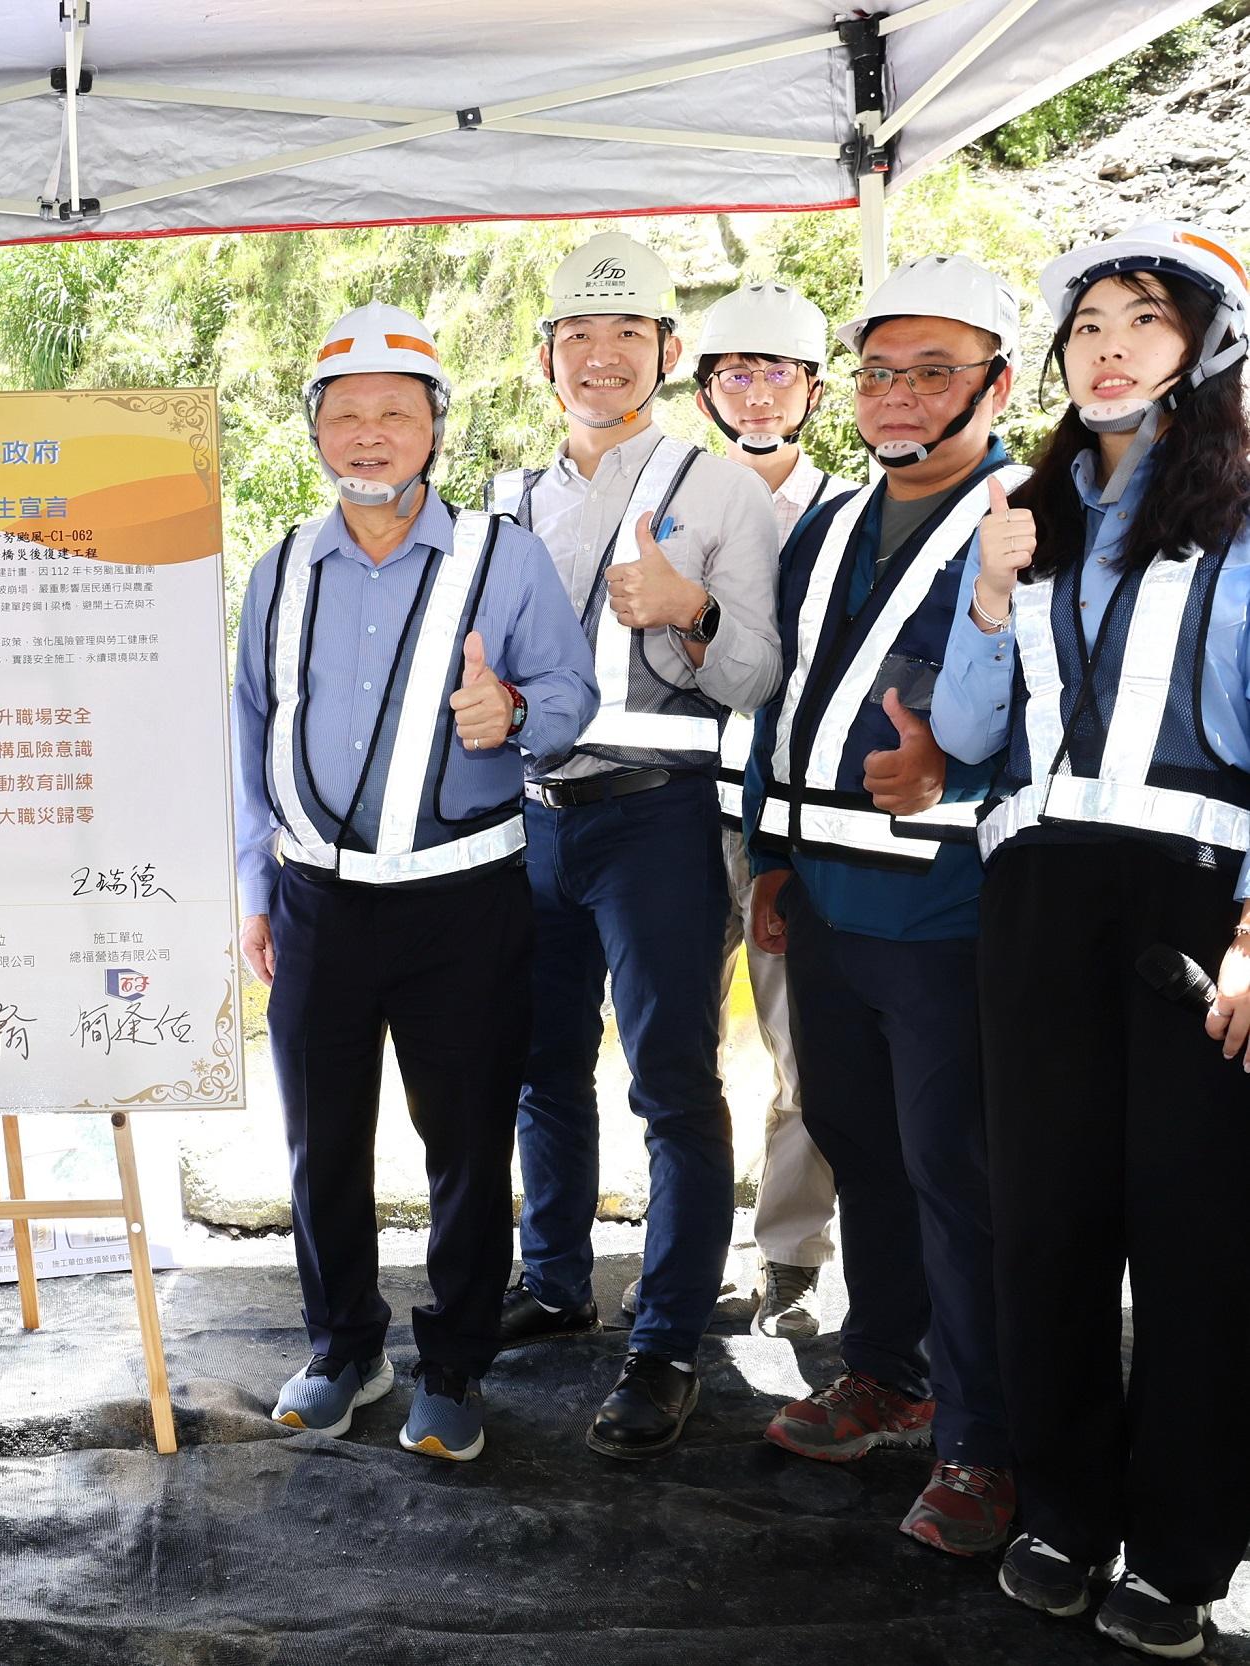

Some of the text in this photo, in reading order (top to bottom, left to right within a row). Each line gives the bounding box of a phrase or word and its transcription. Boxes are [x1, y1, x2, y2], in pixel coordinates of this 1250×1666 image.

[51, 566, 70, 576] 112
[72, 564, 156, 577] 年卡努颱風重創南
[93, 931, 144, 945] 施工單位
[69, 948, 171, 963] 總福營造有限公司
